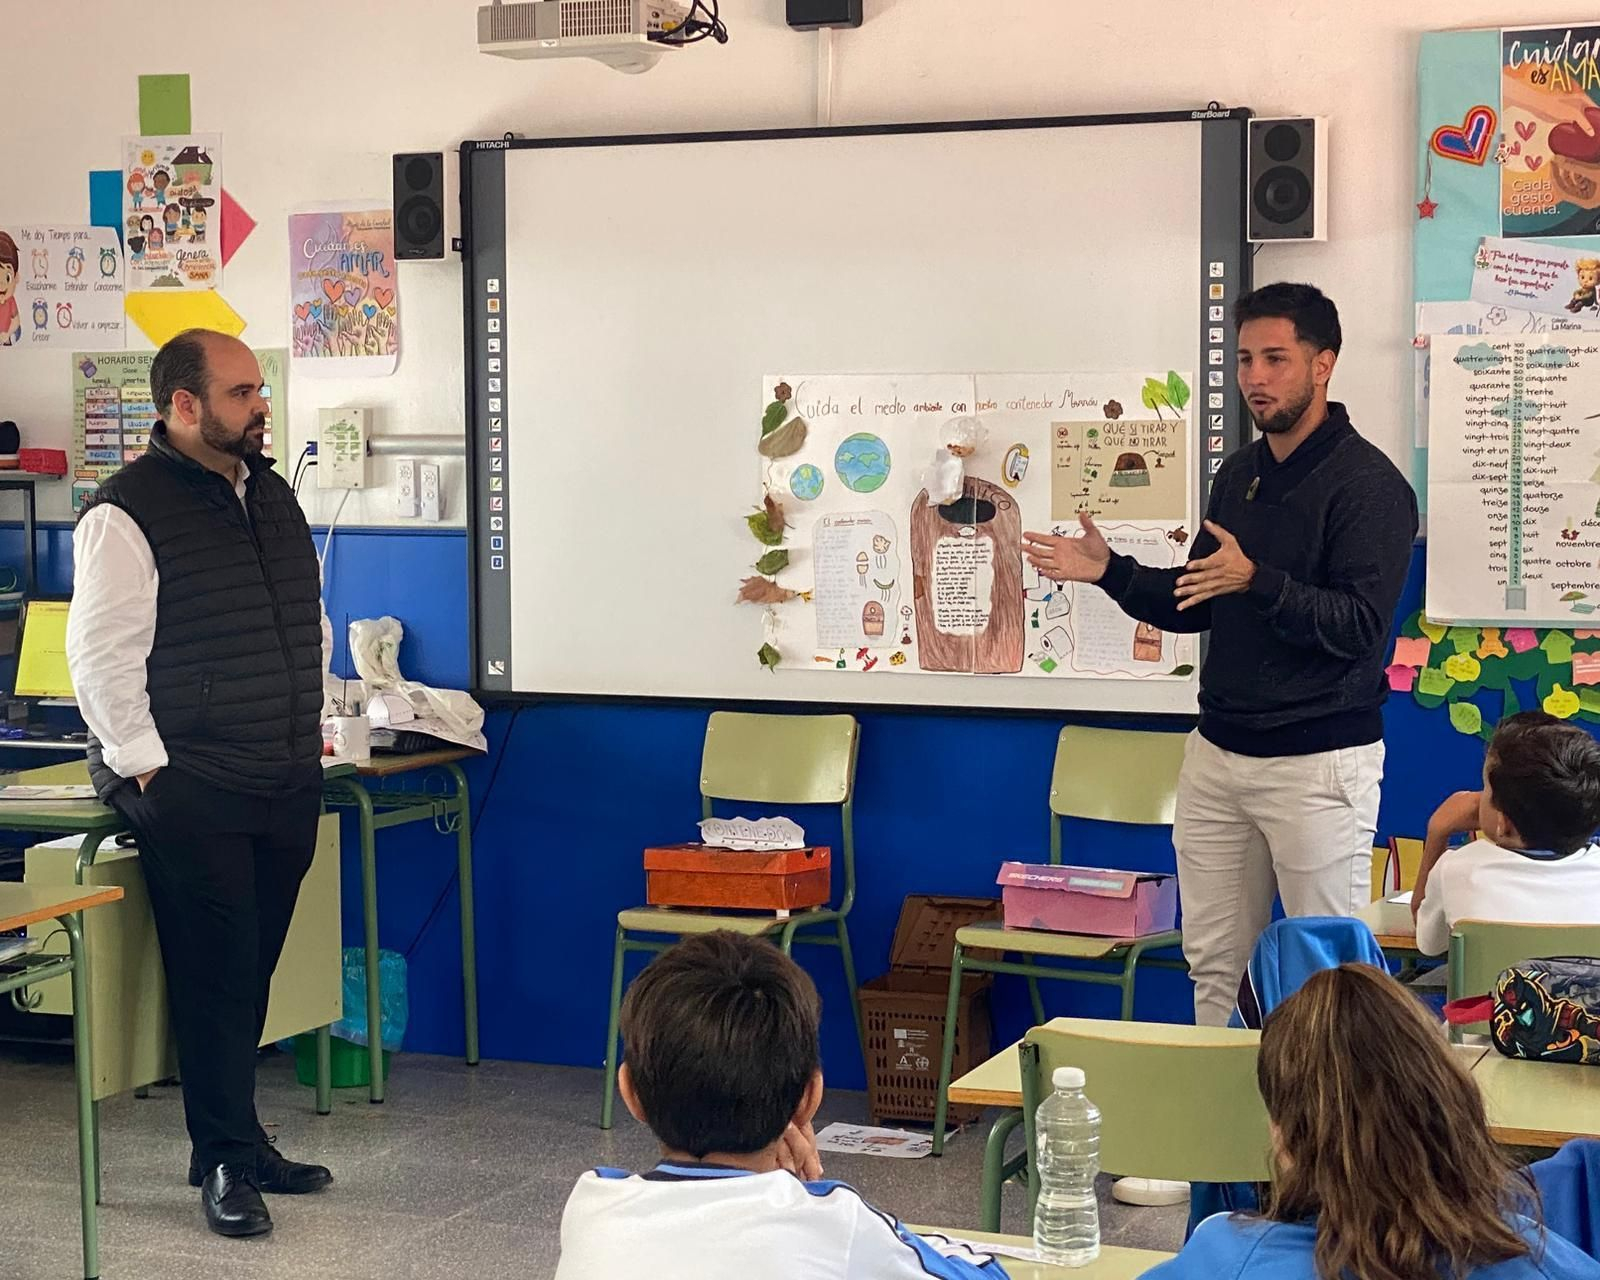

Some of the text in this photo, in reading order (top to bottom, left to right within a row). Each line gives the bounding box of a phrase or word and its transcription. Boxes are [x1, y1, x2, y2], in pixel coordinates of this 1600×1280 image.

[1530, 68, 1549, 84] es
[1191, 110, 1230, 119] StarBoard
[1512, 178, 1552, 192] Cada
[1510, 192, 1554, 206] gesto
[1503, 204, 1560, 216] cuenta.
[22, 230, 31, 240] Me
[176, 249, 208, 264] genera
[340, 251, 390, 278] AMAR
[1552, 322, 1582, 330] La Marina
[1492, 342, 1511, 350] cent
[1526, 344, 1598, 356] quatre-vingt-dix
[98, 356, 136, 365] HORARIO
[1453, 354, 1513, 364] quatre-vingts
[1526, 361, 1580, 370] soixante-dix
[1474, 368, 1510, 376] soixante
[1525, 374, 1568, 382] cinquante
[1470, 381, 1510, 390] quarante
[850, 396, 863, 414] el
[952, 402, 967, 412] con
[1006, 392, 1054, 411] contenedor
[1465, 394, 1509, 404] vingt-neuf
[1524, 401, 1568, 410] vingt-huit
[1465, 406, 1509, 416] vingt-sept
[1524, 415, 1561, 424] vingt-six
[1141, 424, 1167, 434] TIRAR
[1170, 422, 1179, 433] Y
[1466, 420, 1509, 429] vingt-cinq
[1524, 427, 1580, 437] vingt-quatre
[1142, 436, 1168, 448] TIRAR
[1465, 434, 1509, 443] vingt-trois
[1524, 441, 1571, 450] vingt-deux
[1463, 447, 1484, 456] vingt
[1523, 455, 1547, 464] vingt
[1472, 460, 1508, 469] dix-neuf
[1472, 473, 1508, 482] dix-sept
[1480, 487, 1508, 495] quinze
[1523, 492, 1564, 500] quatorze
[1481, 499, 1508, 508] treize
[1522, 505, 1549, 514] douze
[1487, 513, 1508, 521] onze
[1490, 524, 1508, 533] neuf
[1489, 540, 1508, 549] sept
[1556, 540, 1600, 549] novembre
[1490, 551, 1508, 560] cinq
[1522, 558, 1551, 566] quatre
[1550, 582, 1600, 592] septembre
